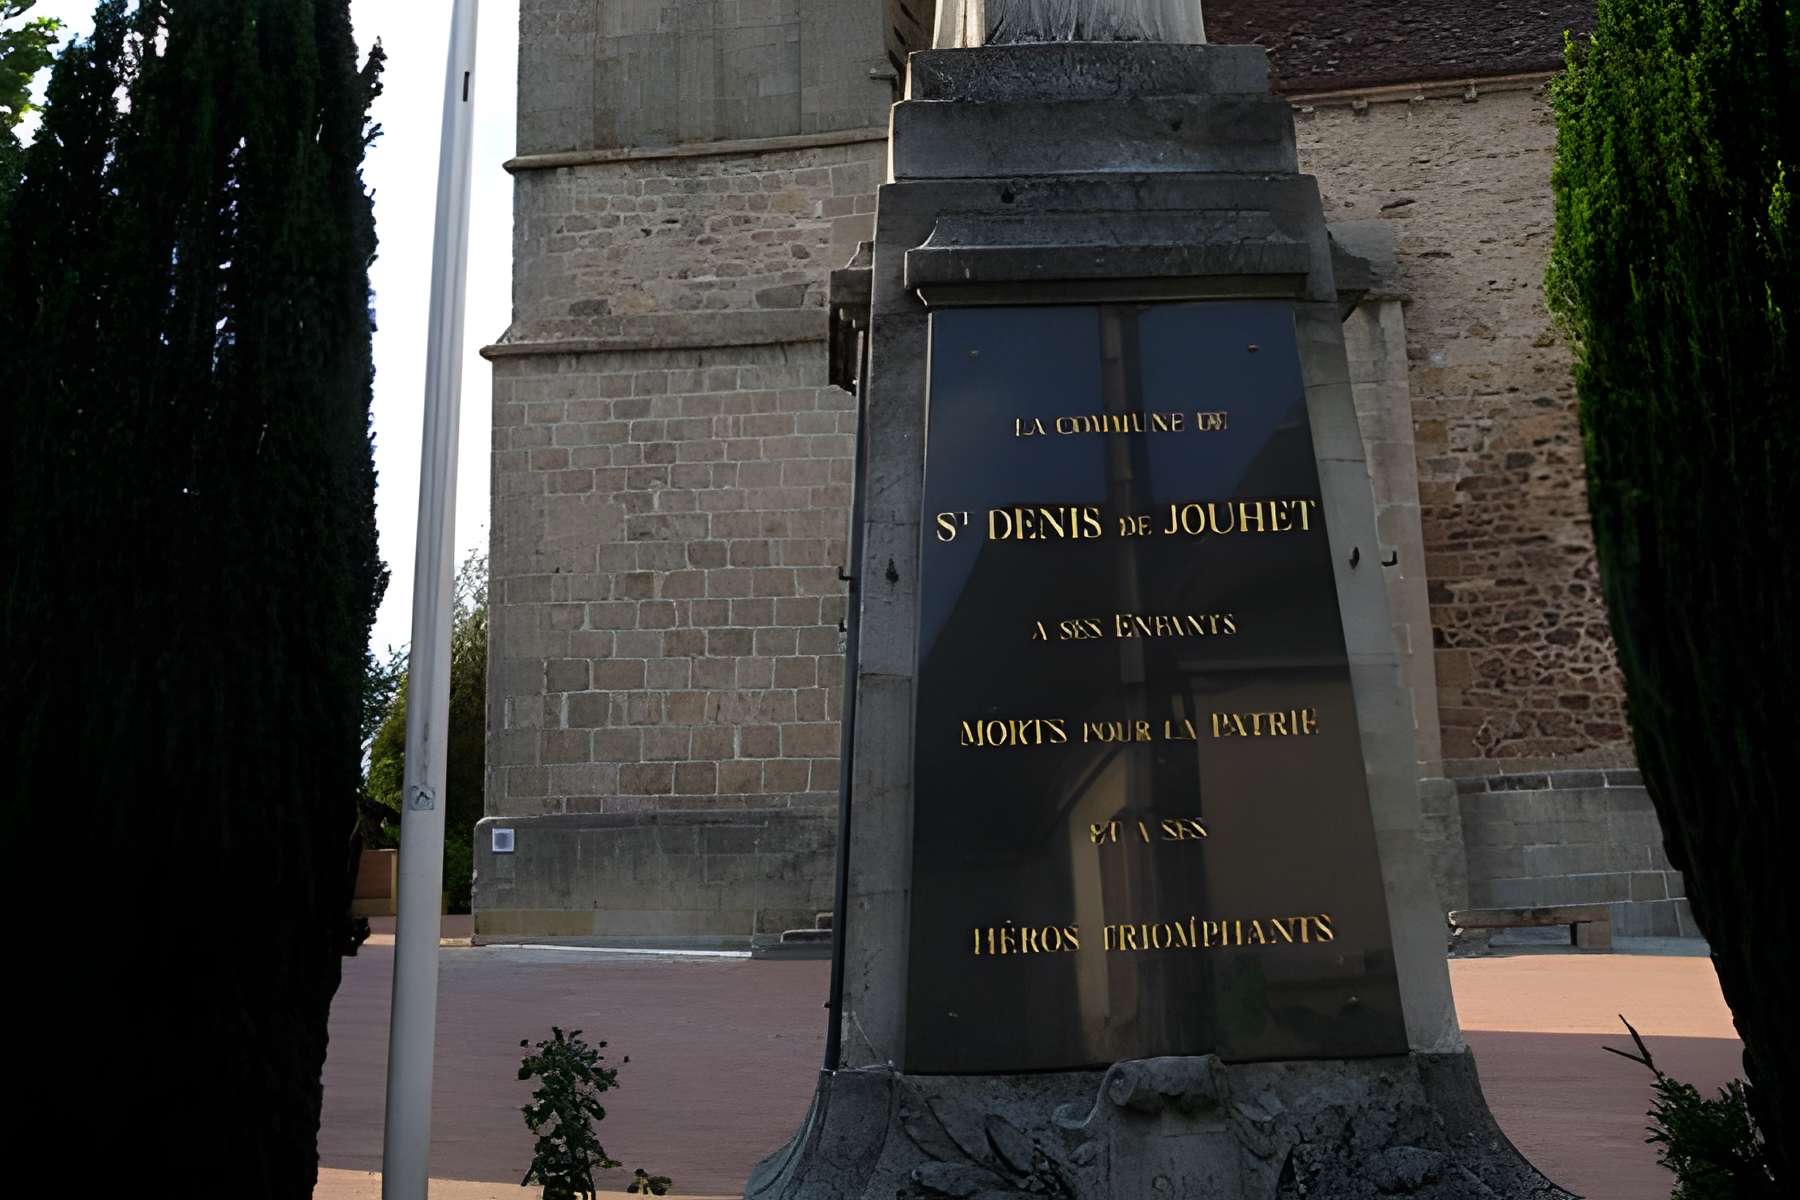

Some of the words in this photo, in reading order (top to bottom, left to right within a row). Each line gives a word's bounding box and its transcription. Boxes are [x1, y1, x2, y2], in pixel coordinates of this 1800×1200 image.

[1015, 416, 1047, 437] LA
[988, 506, 1103, 541] DENIS
[1118, 515, 1152, 537] DE
[1164, 500, 1316, 536] JOUHET
[1059, 617, 1103, 640] SES
[1115, 613, 1237, 638] ENFANTS
[960, 719, 1068, 747] MORTS
[1083, 719, 1152, 744] POUR
[1165, 719, 1197, 741] LA
[1211, 708, 1320, 739] PATRIE
[1160, 817, 1208, 841] SES
[1103, 913, 1335, 952] TRIOMPHANTS
